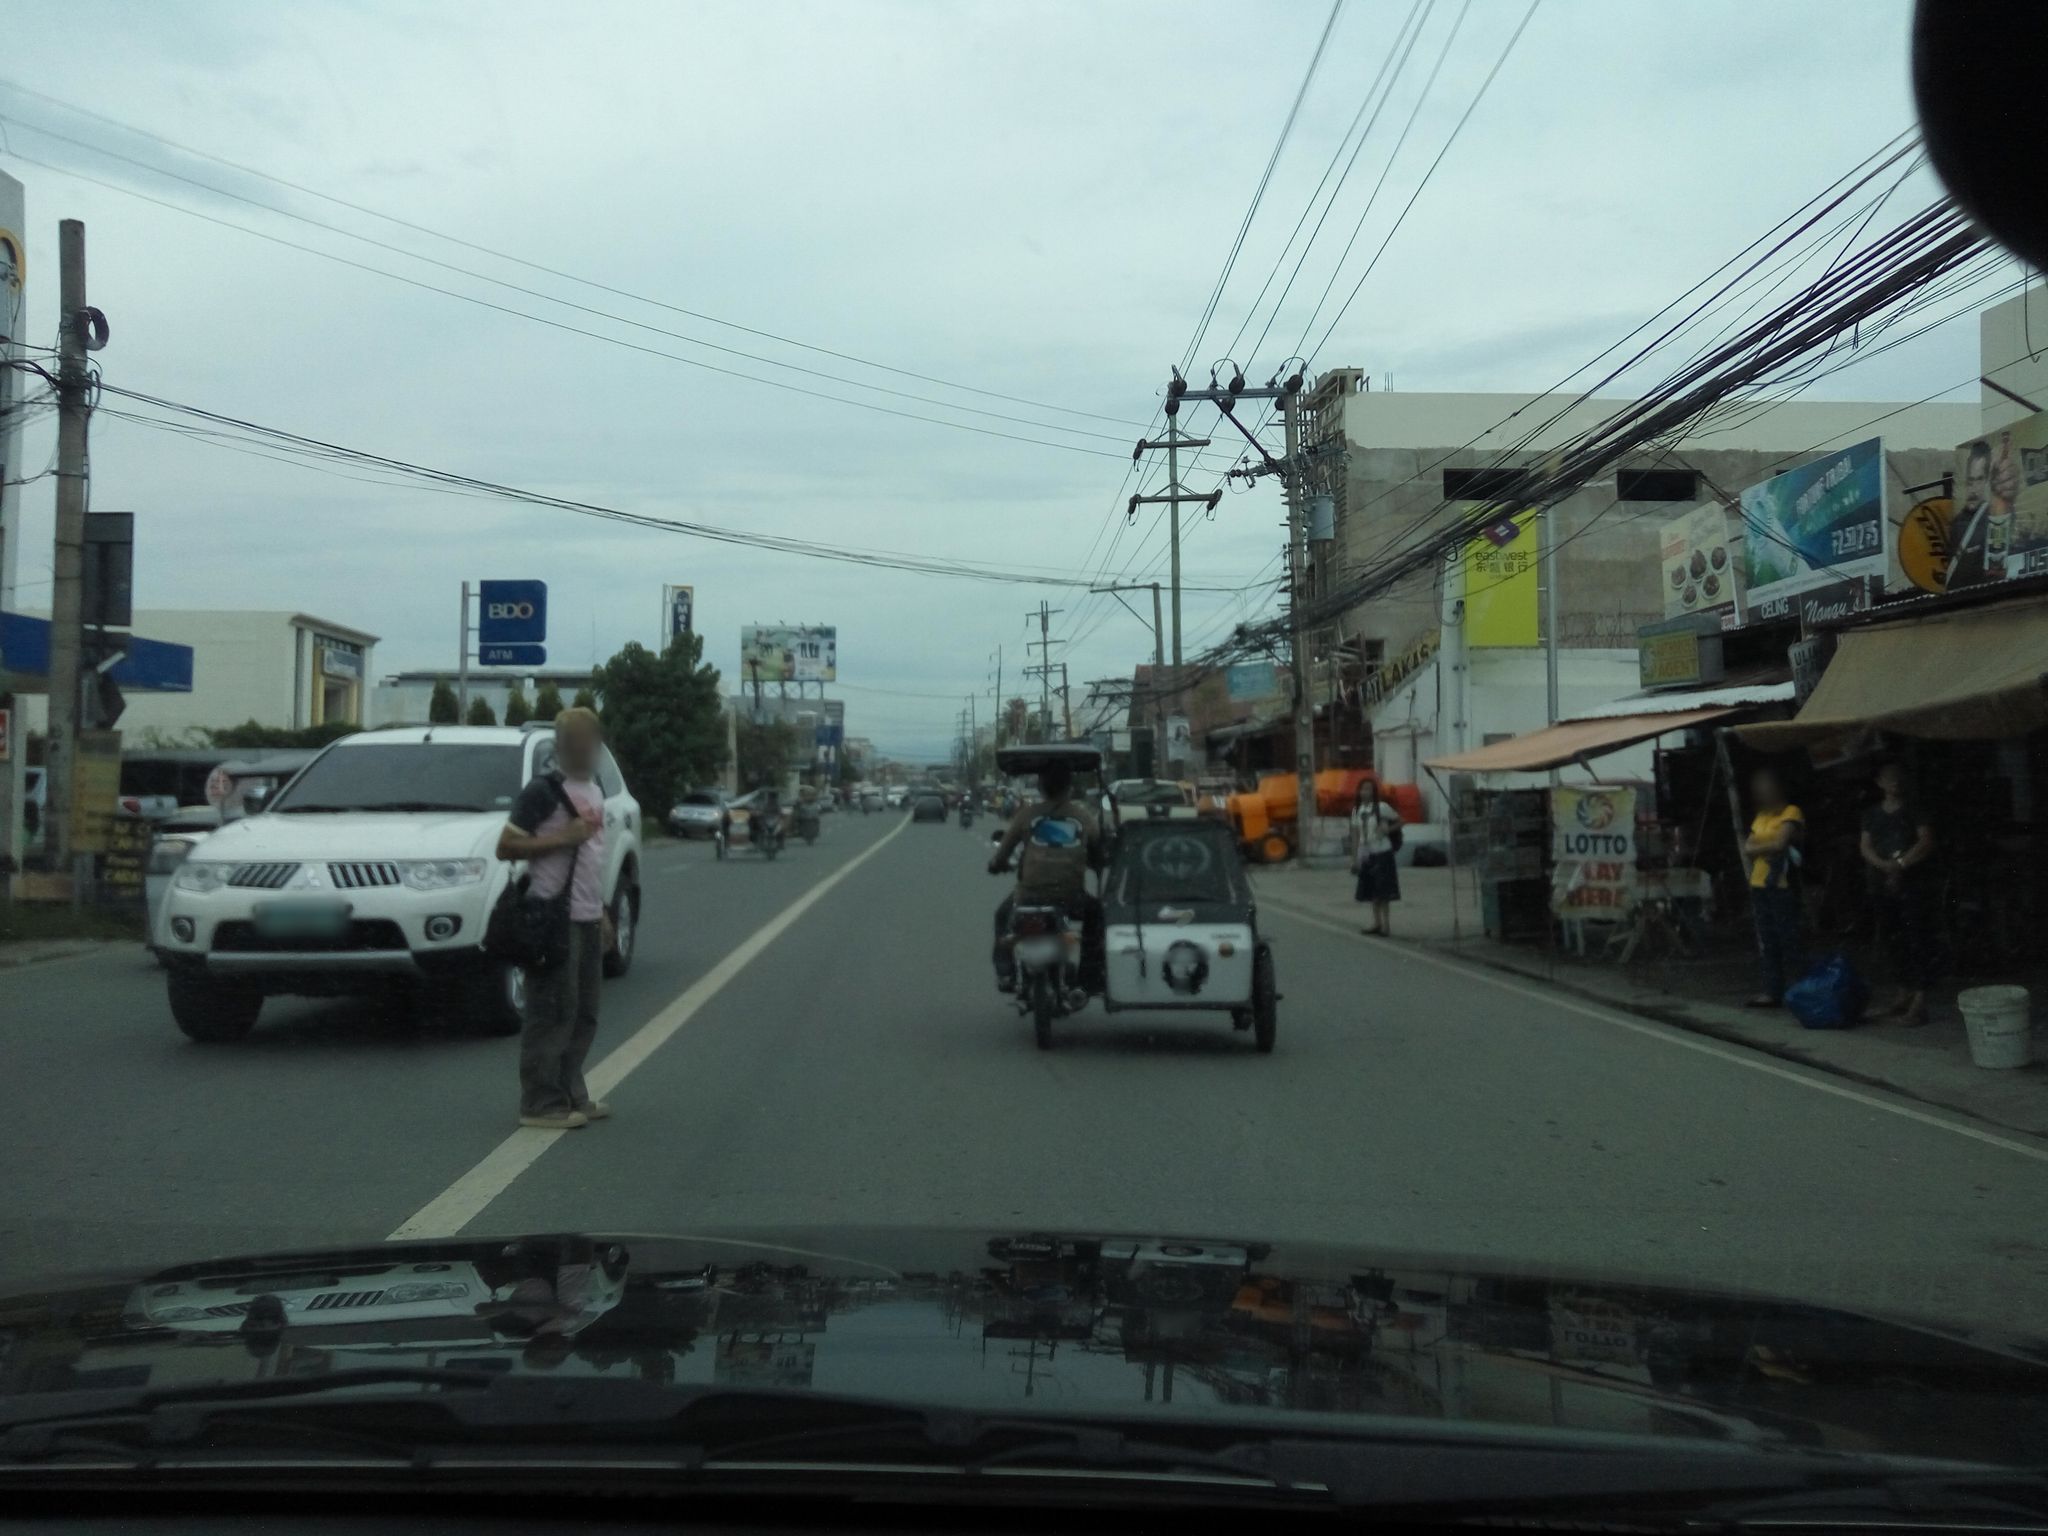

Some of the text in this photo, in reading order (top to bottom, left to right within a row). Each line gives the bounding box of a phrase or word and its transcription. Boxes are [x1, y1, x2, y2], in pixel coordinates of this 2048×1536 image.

[489, 603, 534, 619] BDO
[489, 650, 513, 660] ATM
[1566, 834, 1627, 854] LOTTO
